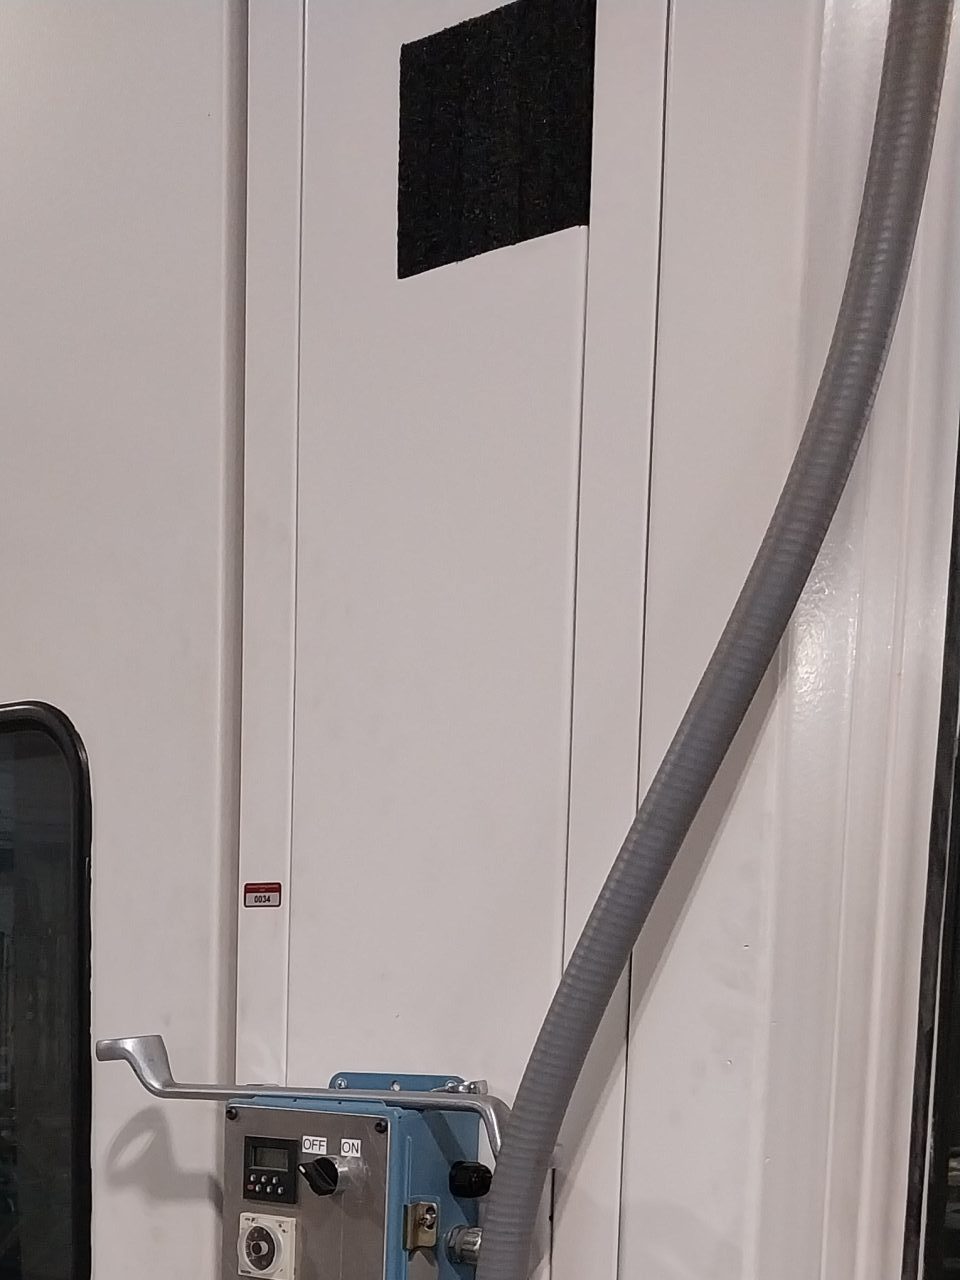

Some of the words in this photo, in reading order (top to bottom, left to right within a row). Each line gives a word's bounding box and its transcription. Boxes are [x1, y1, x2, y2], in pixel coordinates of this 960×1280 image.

[254, 895, 271, 904] 0034
[303, 1138, 326, 1152] OFF
[342, 1141, 359, 1154] ON
